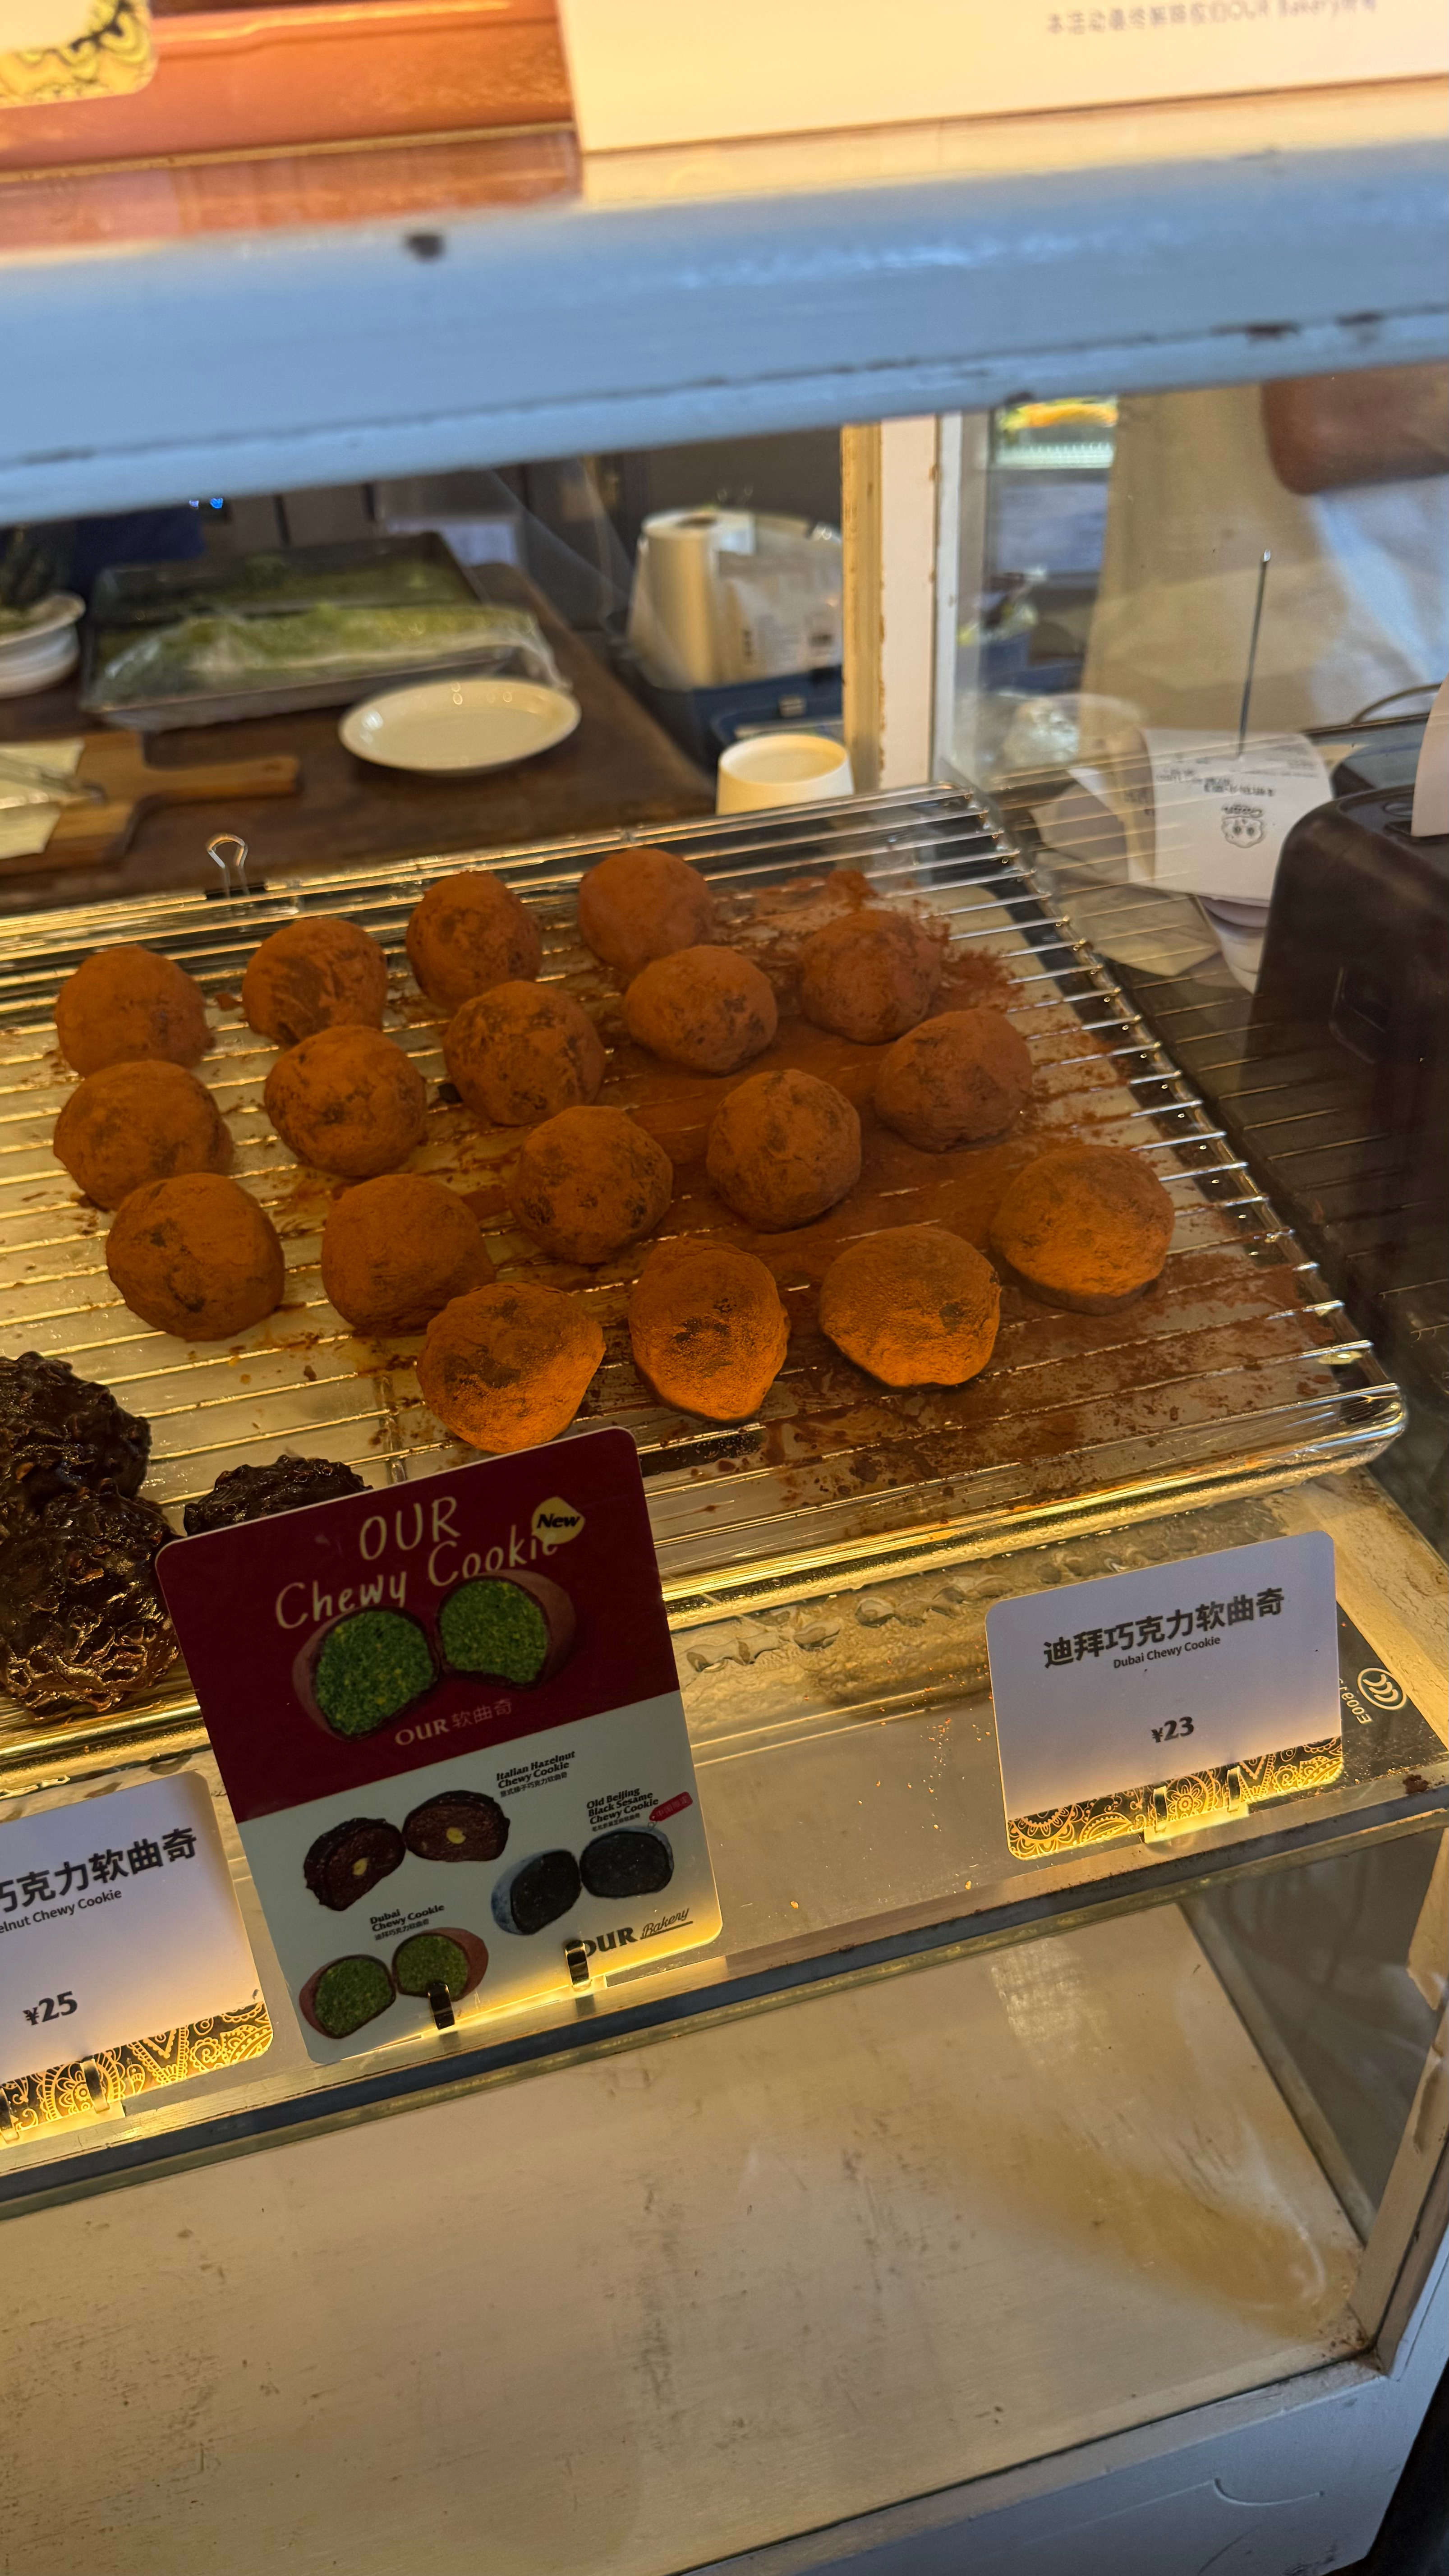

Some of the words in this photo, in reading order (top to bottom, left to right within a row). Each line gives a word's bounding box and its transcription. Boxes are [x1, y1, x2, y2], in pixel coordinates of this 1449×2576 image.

[360, 1496, 461, 1560] OUR
[537, 1513, 581, 1528] New
[276, 1571, 407, 1629] Chewy
[428, 1524, 559, 1587] Cookie
[1044, 1587, 1284, 1668] 迪拜巧克力软曲奇
[1113, 1653, 1144, 1668] Dubai
[1147, 1645, 1182, 1660] Chewy
[1184, 1636, 1220, 1652] Cookie
[395, 1719, 450, 1745] OUR
[452, 1698, 512, 1728] 软曲奇
[1151, 1716, 1194, 1743] ¥23
[497, 1766, 529, 1781] Italian
[531, 1751, 575, 1771] Hazelnut
[498, 1773, 531, 1789] Chewy
[534, 1762, 570, 1778] Cookie
[587, 1798, 604, 1809] Old
[607, 1788, 640, 1804] Beijing
[588, 1803, 616, 1817] Black
[616, 1793, 653, 1809] Sesame
[590, 1809, 622, 1825] Chewy
[624, 1799, 659, 1814] Cookie
[32, 1903, 75, 1923] Chewy
[78, 1889, 122, 1909] Cookie
[370, 1909, 400, 1924] Dubai
[372, 1917, 406, 1932] Chewy
[408, 1905, 444, 1920] Cookie
[642, 1908, 690, 1938] Bakery
[23, 1991, 78, 2025] ¥25
